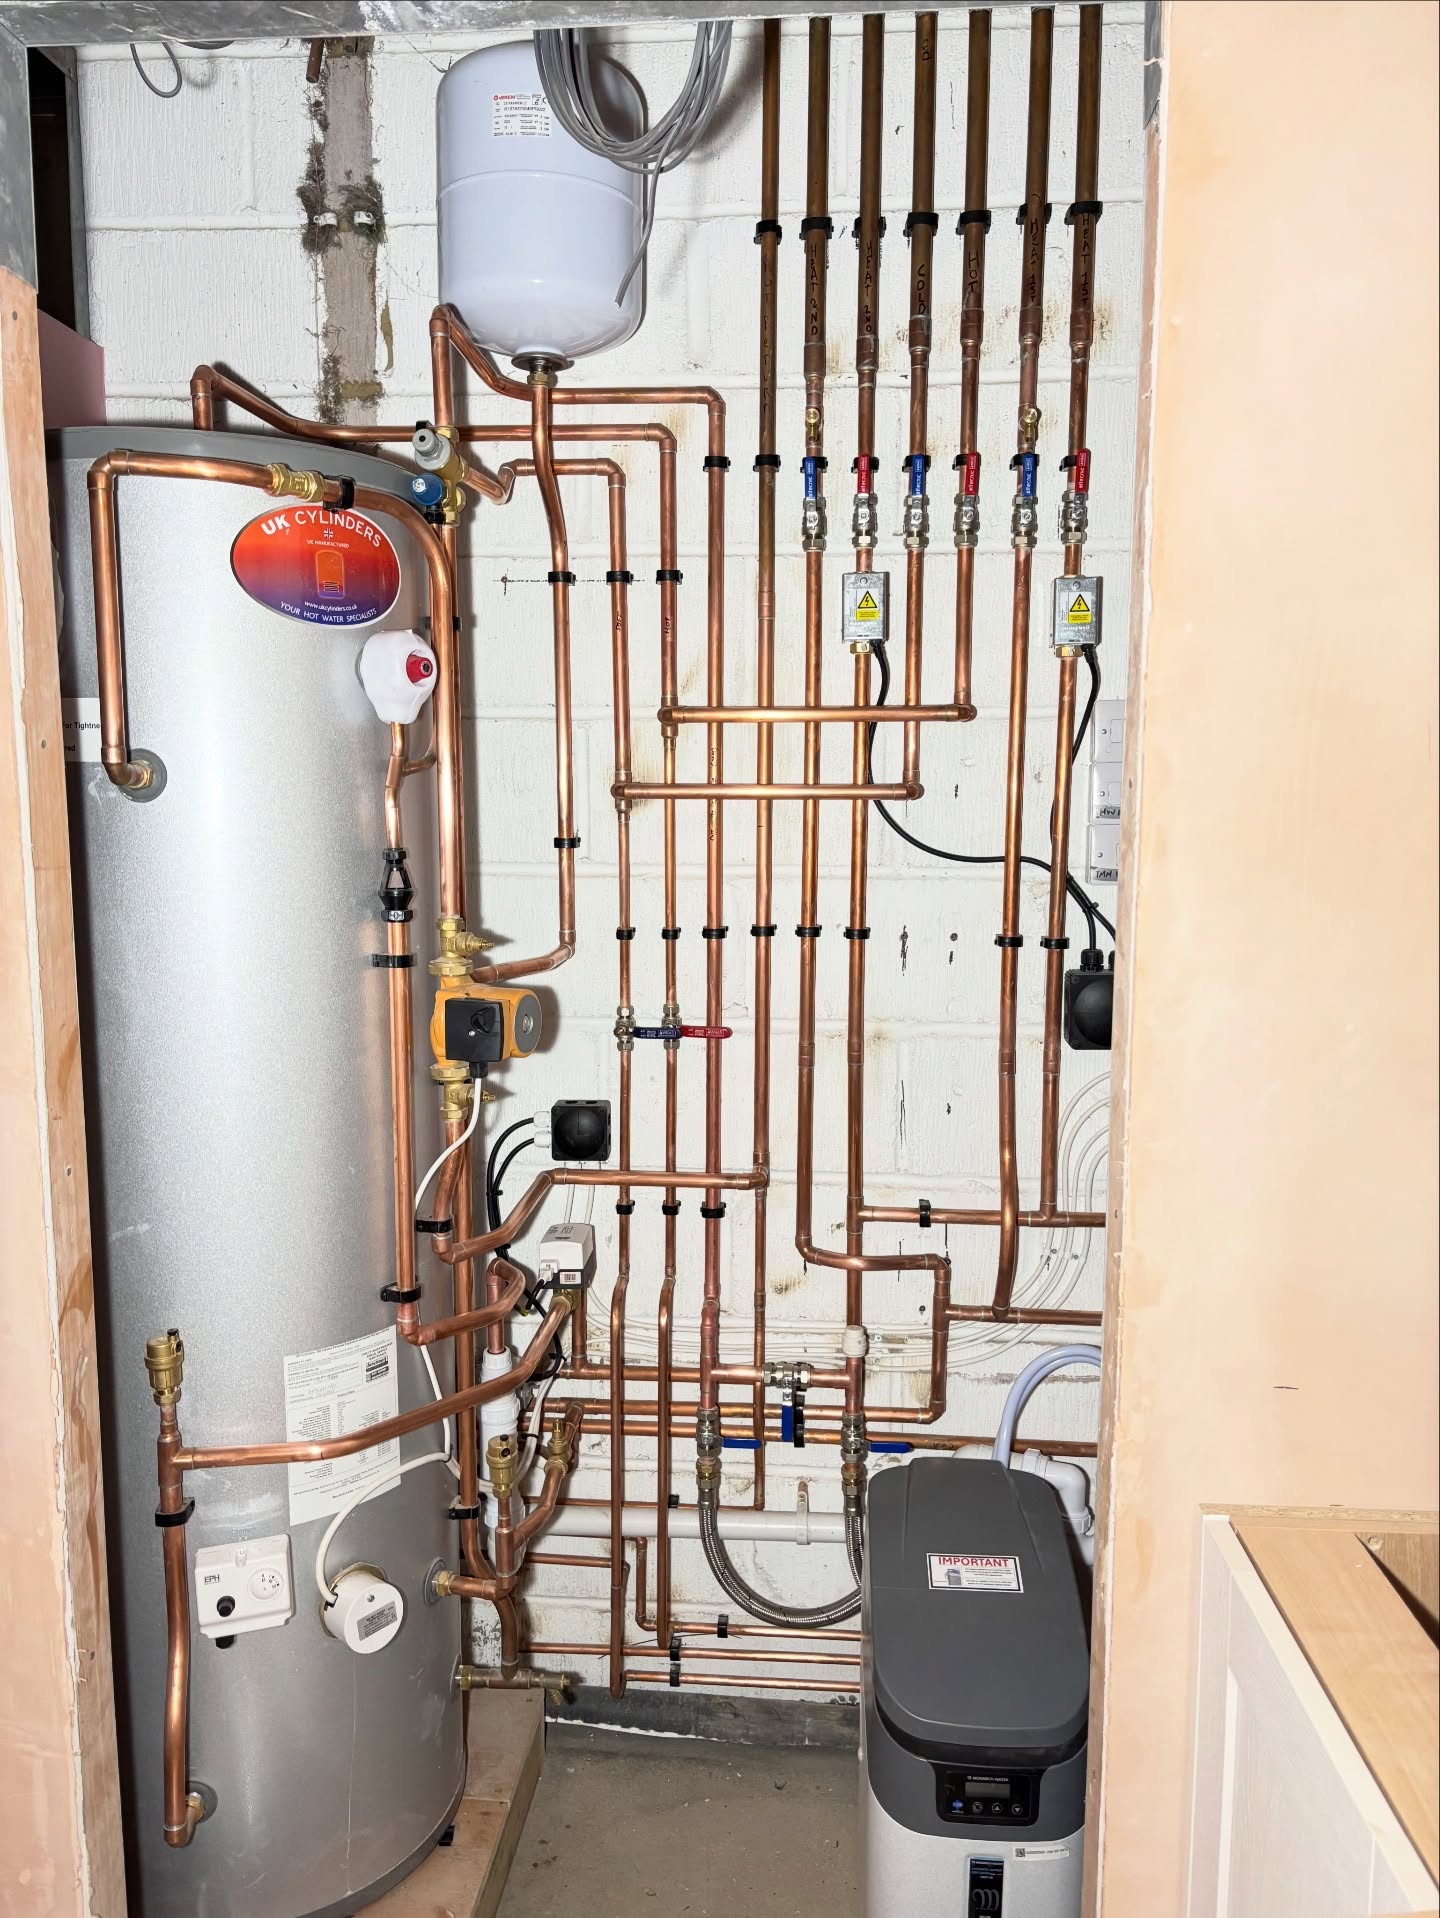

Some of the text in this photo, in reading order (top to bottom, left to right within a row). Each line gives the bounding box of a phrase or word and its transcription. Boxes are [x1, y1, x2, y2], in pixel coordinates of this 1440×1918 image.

[810, 244, 819, 292] HEAT
[968, 251, 980, 293] HOT
[917, 264, 927, 314] COLD
[261, 510, 382, 548] UK CYLINDERS
[314, 540, 350, 549] MANUFACTURED
[281, 601, 377, 623] YOUR HOT WATER SPECIALISTS
[304, 601, 357, 613] www.ukcylinders.co.uk
[939, 1557, 1008, 1567] IMPORTANT
[204, 1574, 220, 1583] EPH
